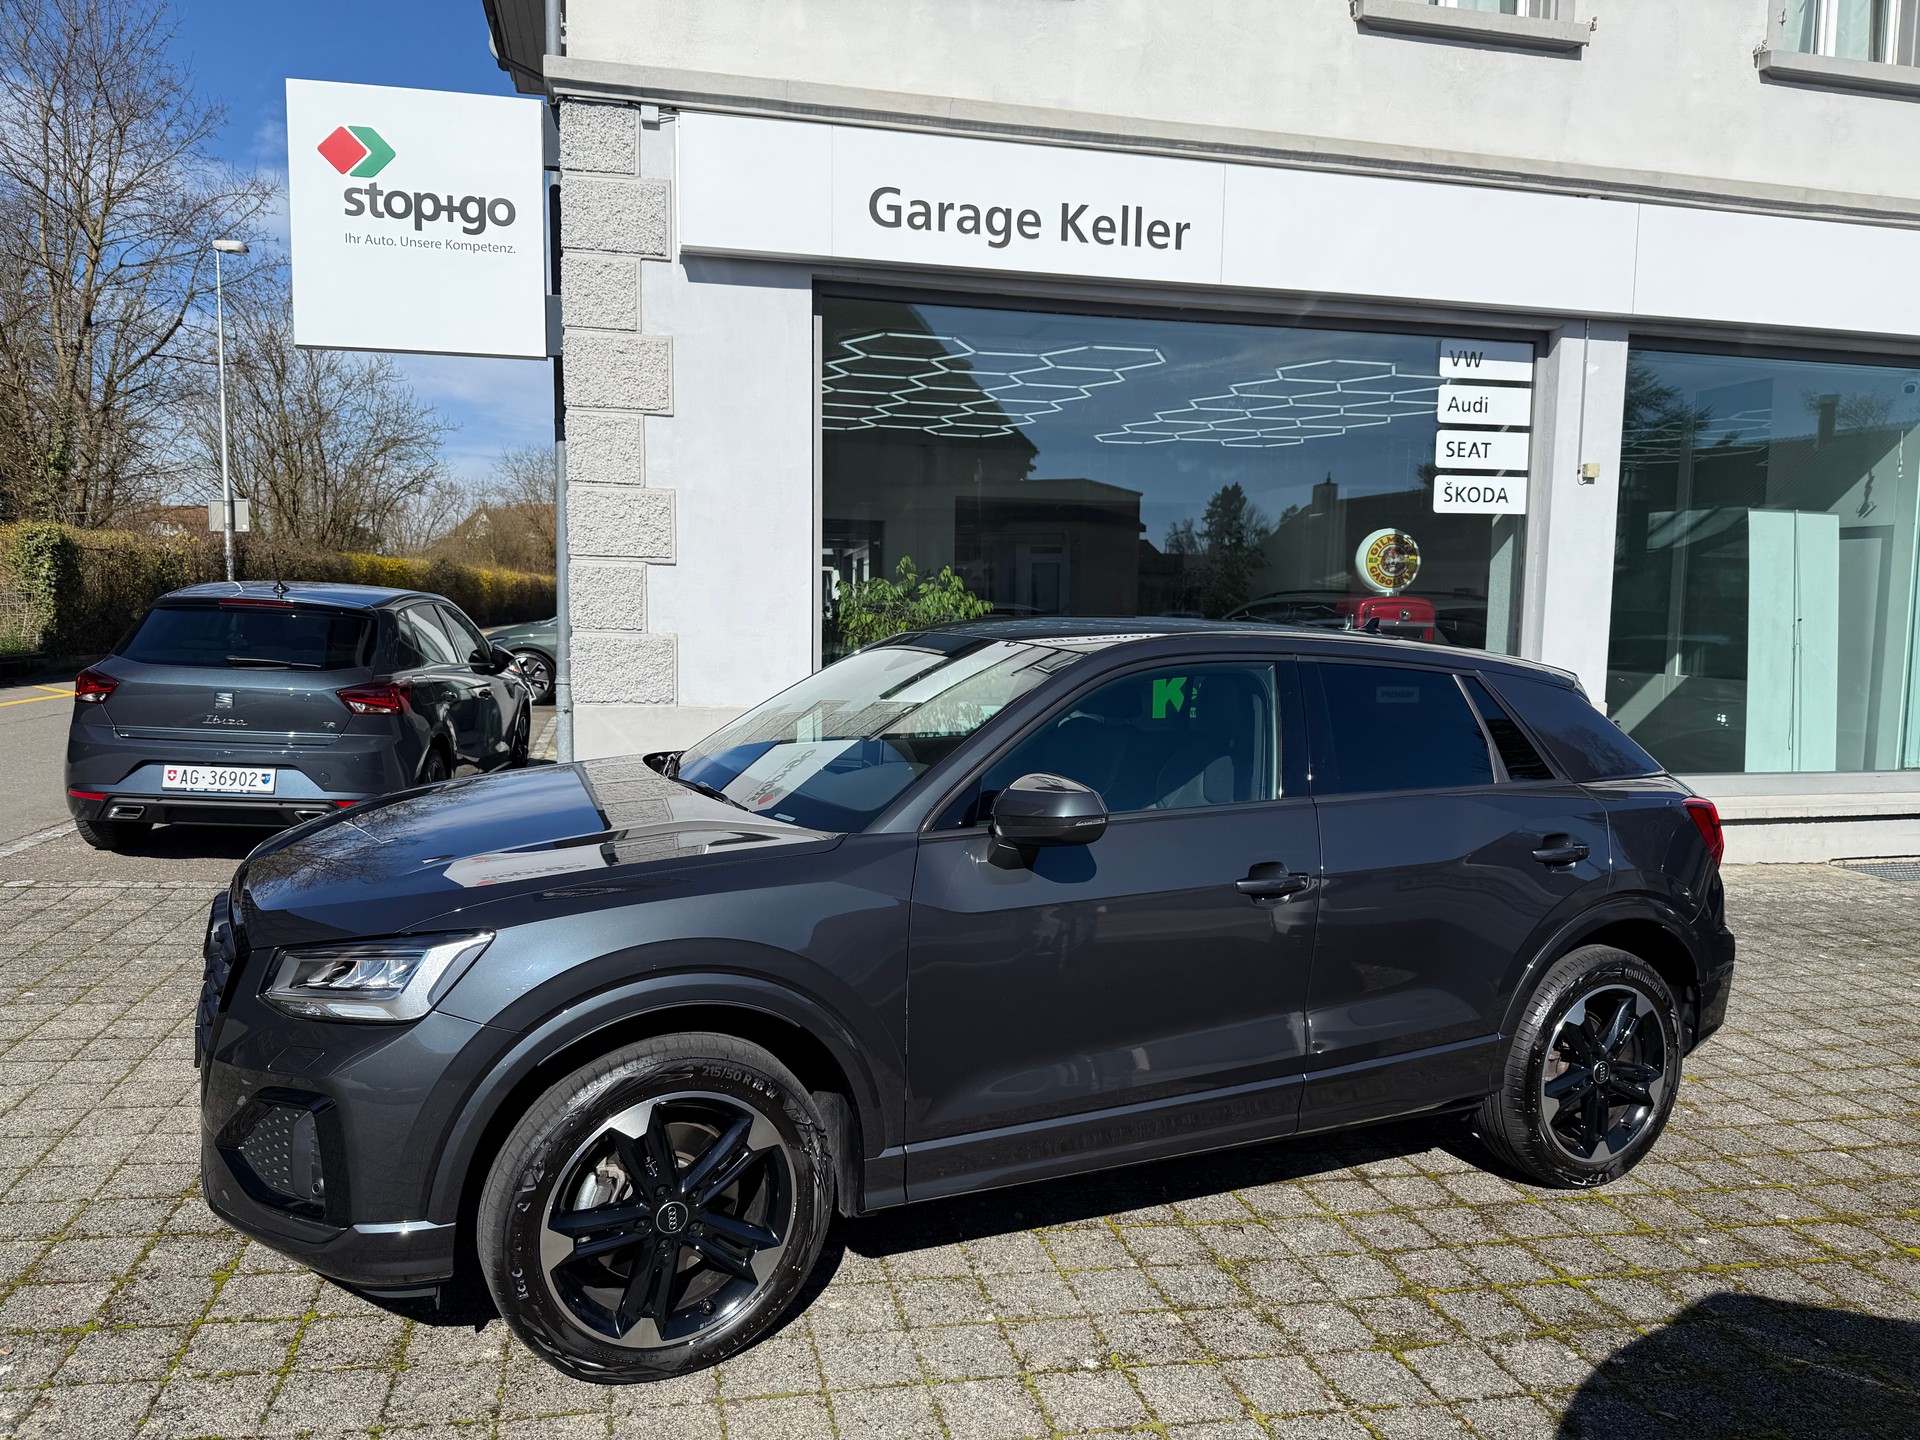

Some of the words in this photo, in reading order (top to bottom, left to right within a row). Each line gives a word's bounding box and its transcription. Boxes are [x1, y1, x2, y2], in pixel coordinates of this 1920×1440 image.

[343, 182, 516, 235] stop+go
[868, 186, 1042, 249] Garage
[1060, 202, 1191, 251] Keller
[344, 232, 362, 244] Ihr
[364, 234, 397, 247] Auto.
[400, 236, 442, 250] Unsere
[445, 239, 516, 254] Kompetenz.
[1449, 350, 1484, 368] VW
[1447, 396, 1489, 414] Audi
[1445, 441, 1492, 459] SEAT
[1443, 481, 1509, 504] ŠKODA
[202, 714, 248, 726] Ibiza
[702, 1065, 742, 1082] 215/50
[742, 1073, 752, 1086] R
[752, 1077, 765, 1091] 18
